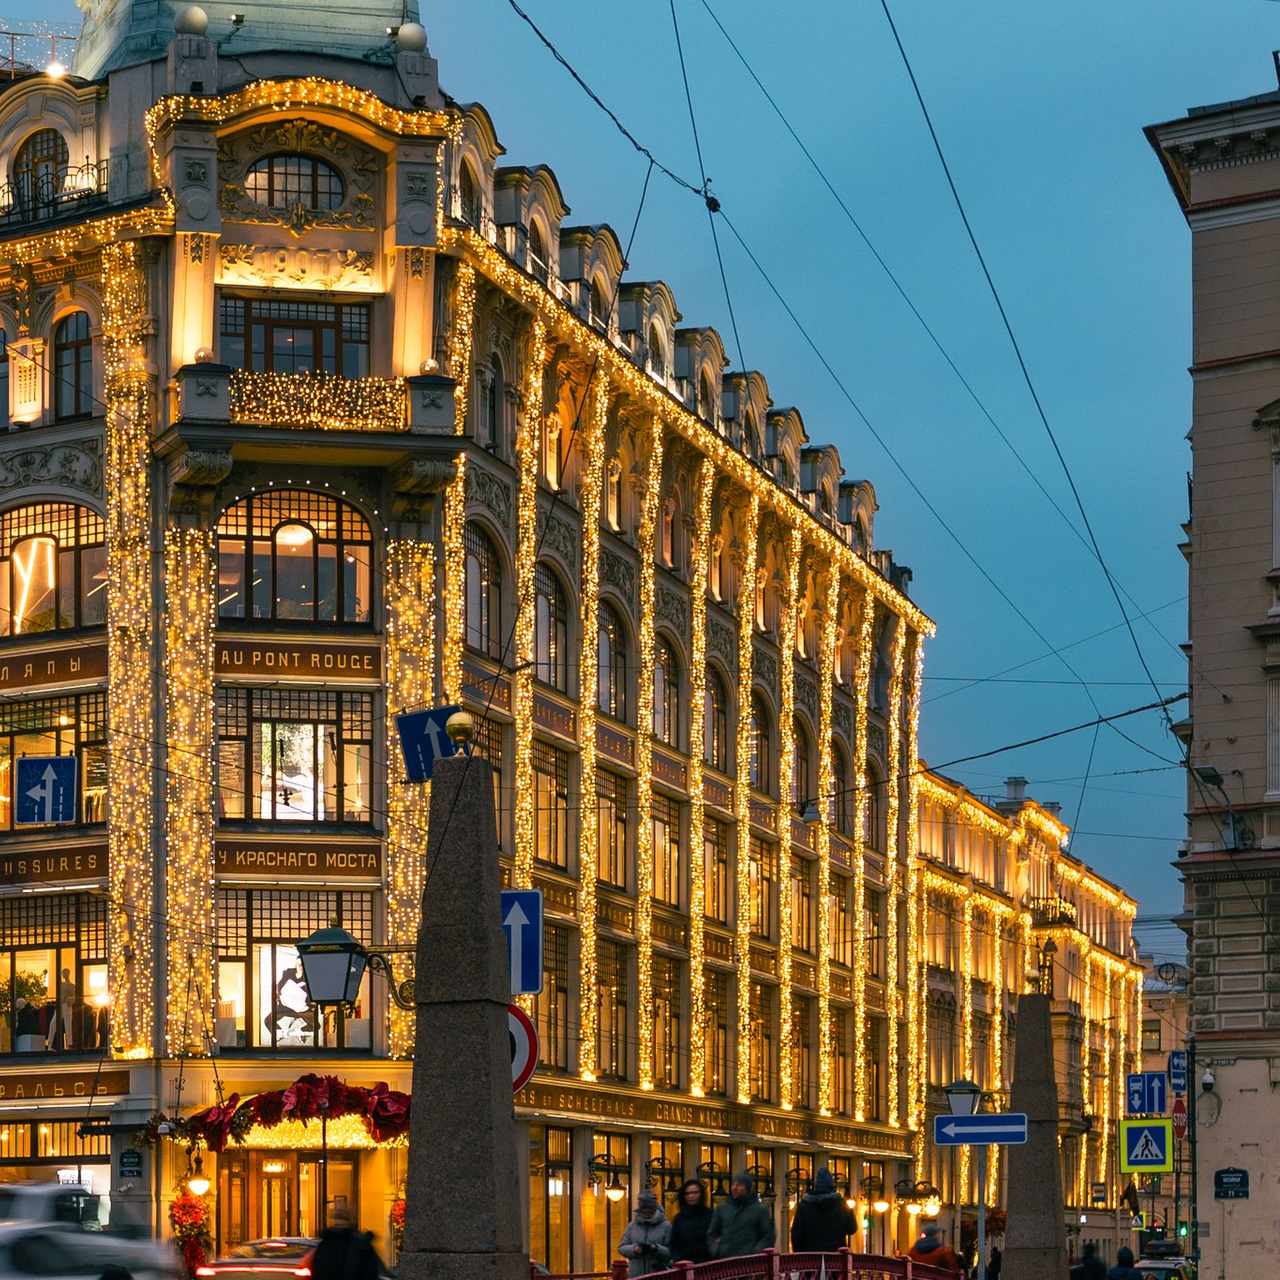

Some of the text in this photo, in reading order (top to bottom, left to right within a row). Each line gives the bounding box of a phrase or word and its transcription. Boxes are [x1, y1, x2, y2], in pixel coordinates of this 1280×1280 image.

[260, 249, 330, 276] 1907
[221, 650, 373, 669] AU PONT ROUGE
[218, 850, 377, 868] У КРАСНАГО МОСТА
[1173, 1113, 1187, 1126] STOP
